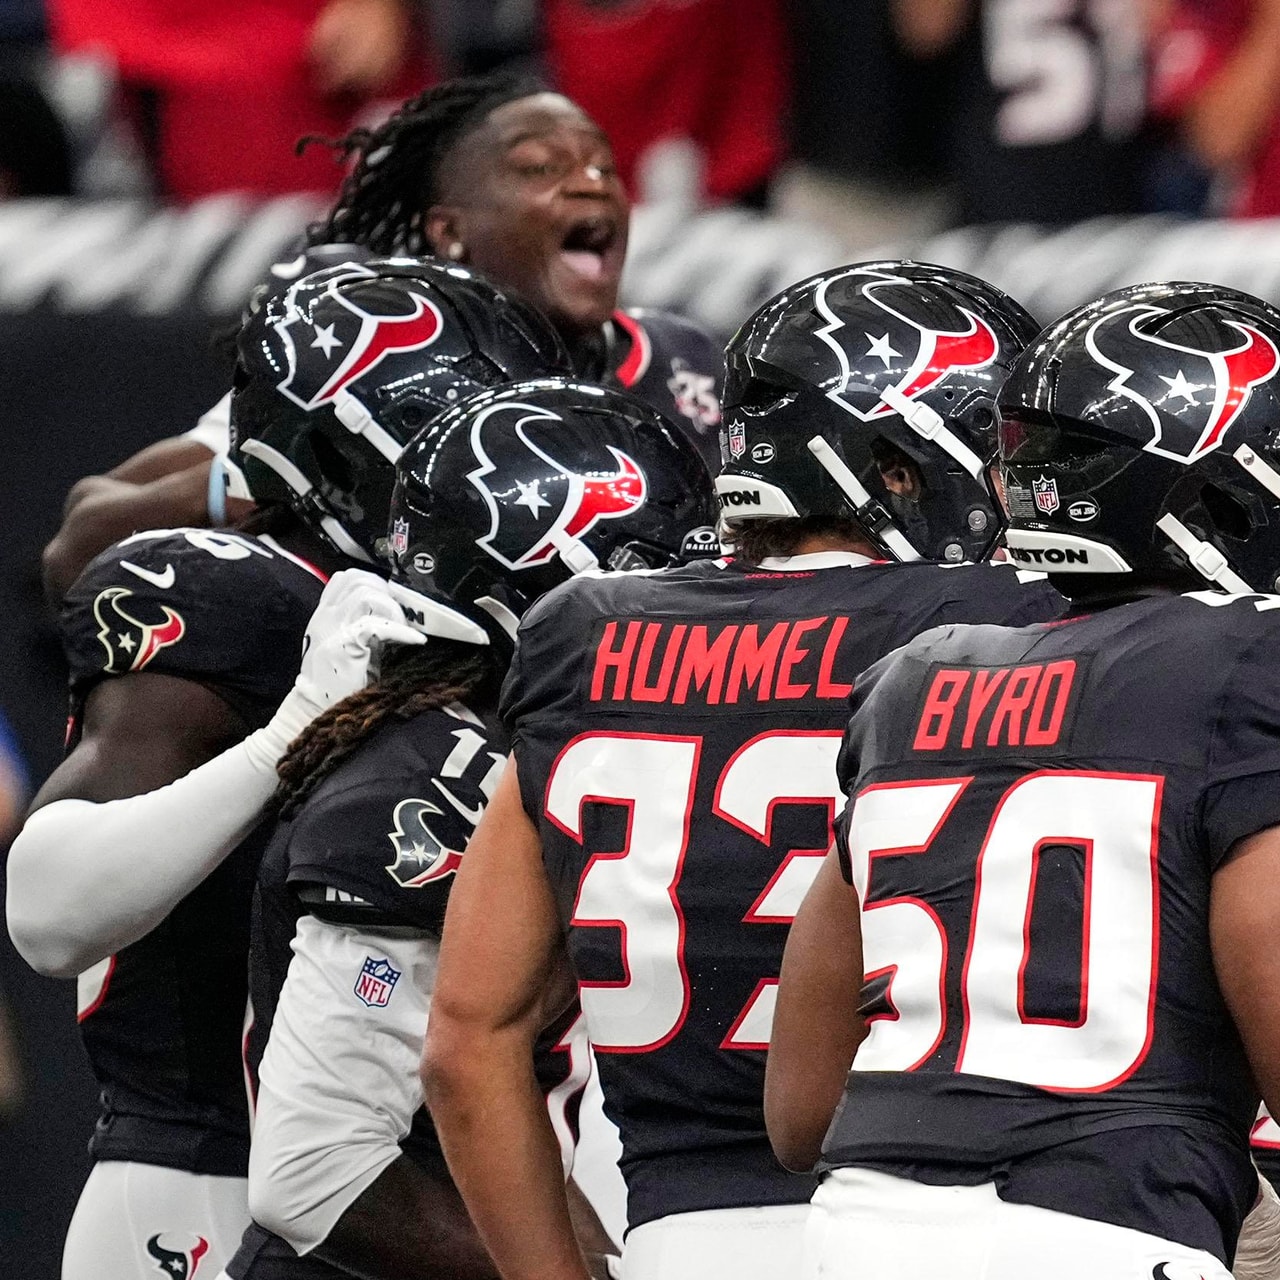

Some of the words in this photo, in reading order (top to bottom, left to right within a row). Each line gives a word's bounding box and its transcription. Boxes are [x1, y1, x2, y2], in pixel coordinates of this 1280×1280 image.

[718, 490, 761, 508] TON
[1037, 492, 1057, 510] NFL
[590, 616, 856, 705] HUMMEL
[913, 659, 1077, 751] BYRD
[849, 769, 1165, 1093] 50
[357, 974, 387, 1004] NFL
